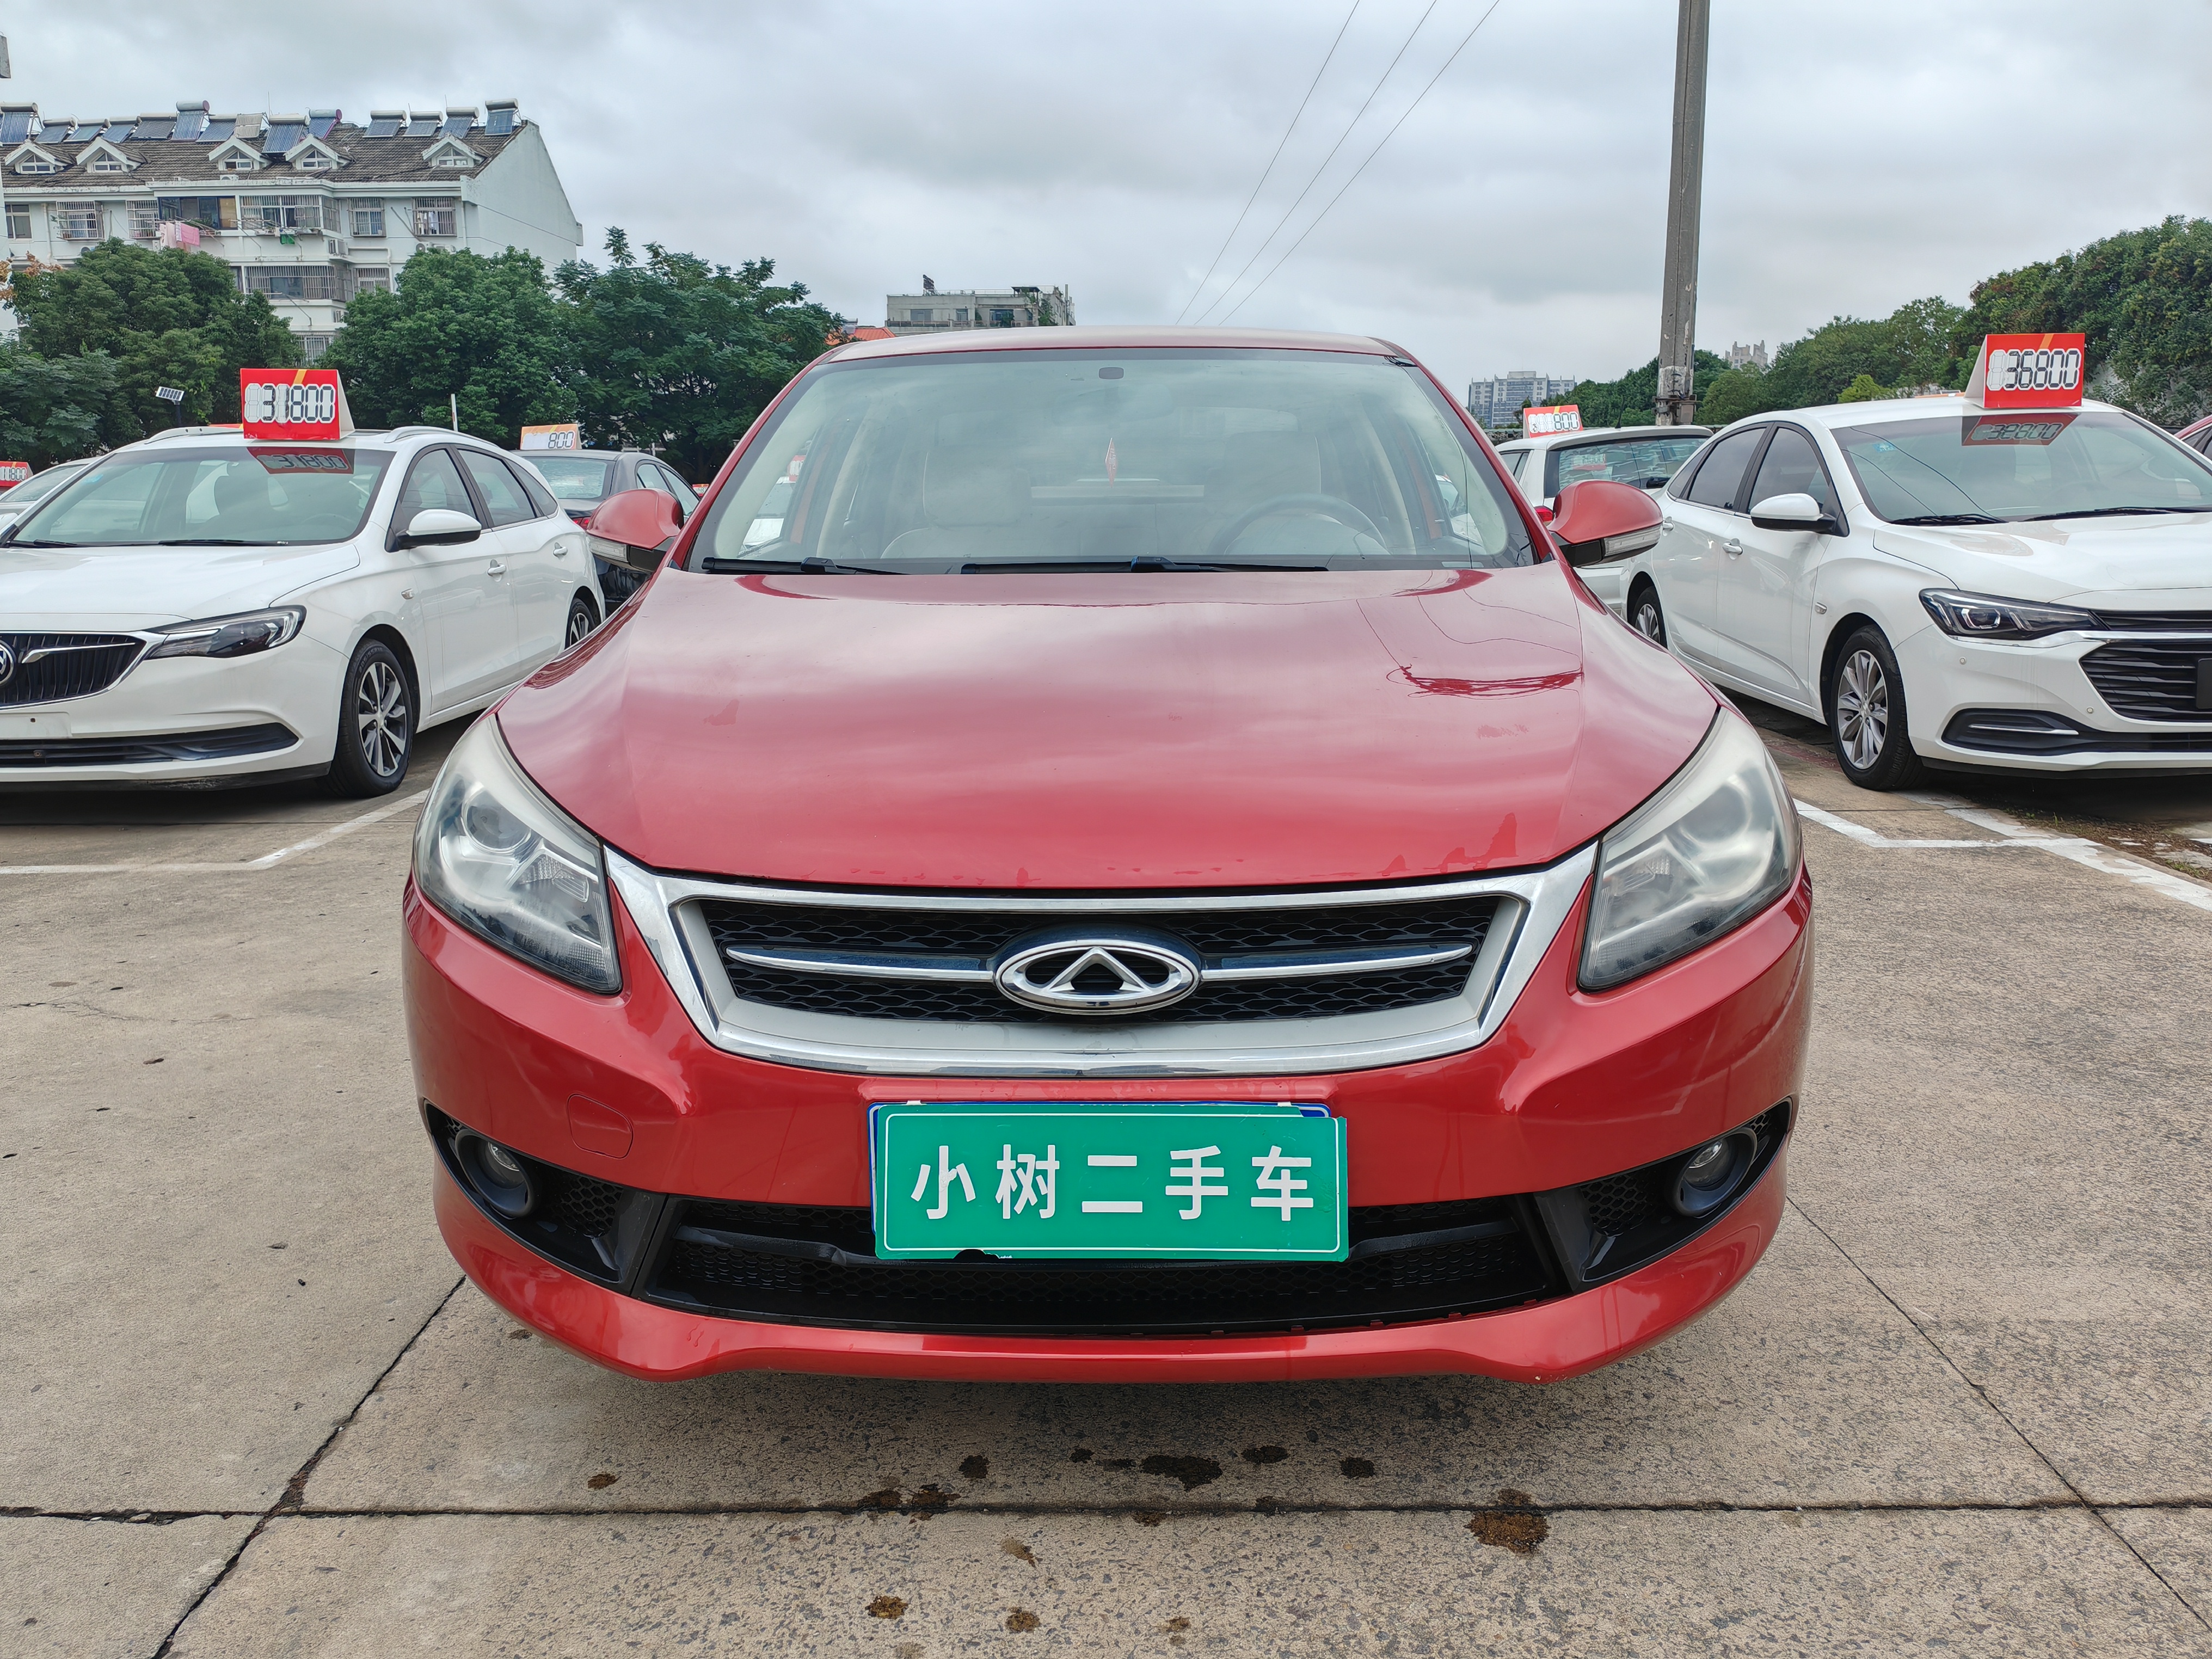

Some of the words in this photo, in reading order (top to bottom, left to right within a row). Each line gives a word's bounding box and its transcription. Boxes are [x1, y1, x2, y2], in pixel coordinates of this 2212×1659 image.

[2005, 350, 2080, 389] 36800
[262, 384, 335, 422] 31800
[1553, 412, 1578, 431] 800
[548, 431, 575, 449] 800
[910, 1144, 1314, 1222] 小树二手车
